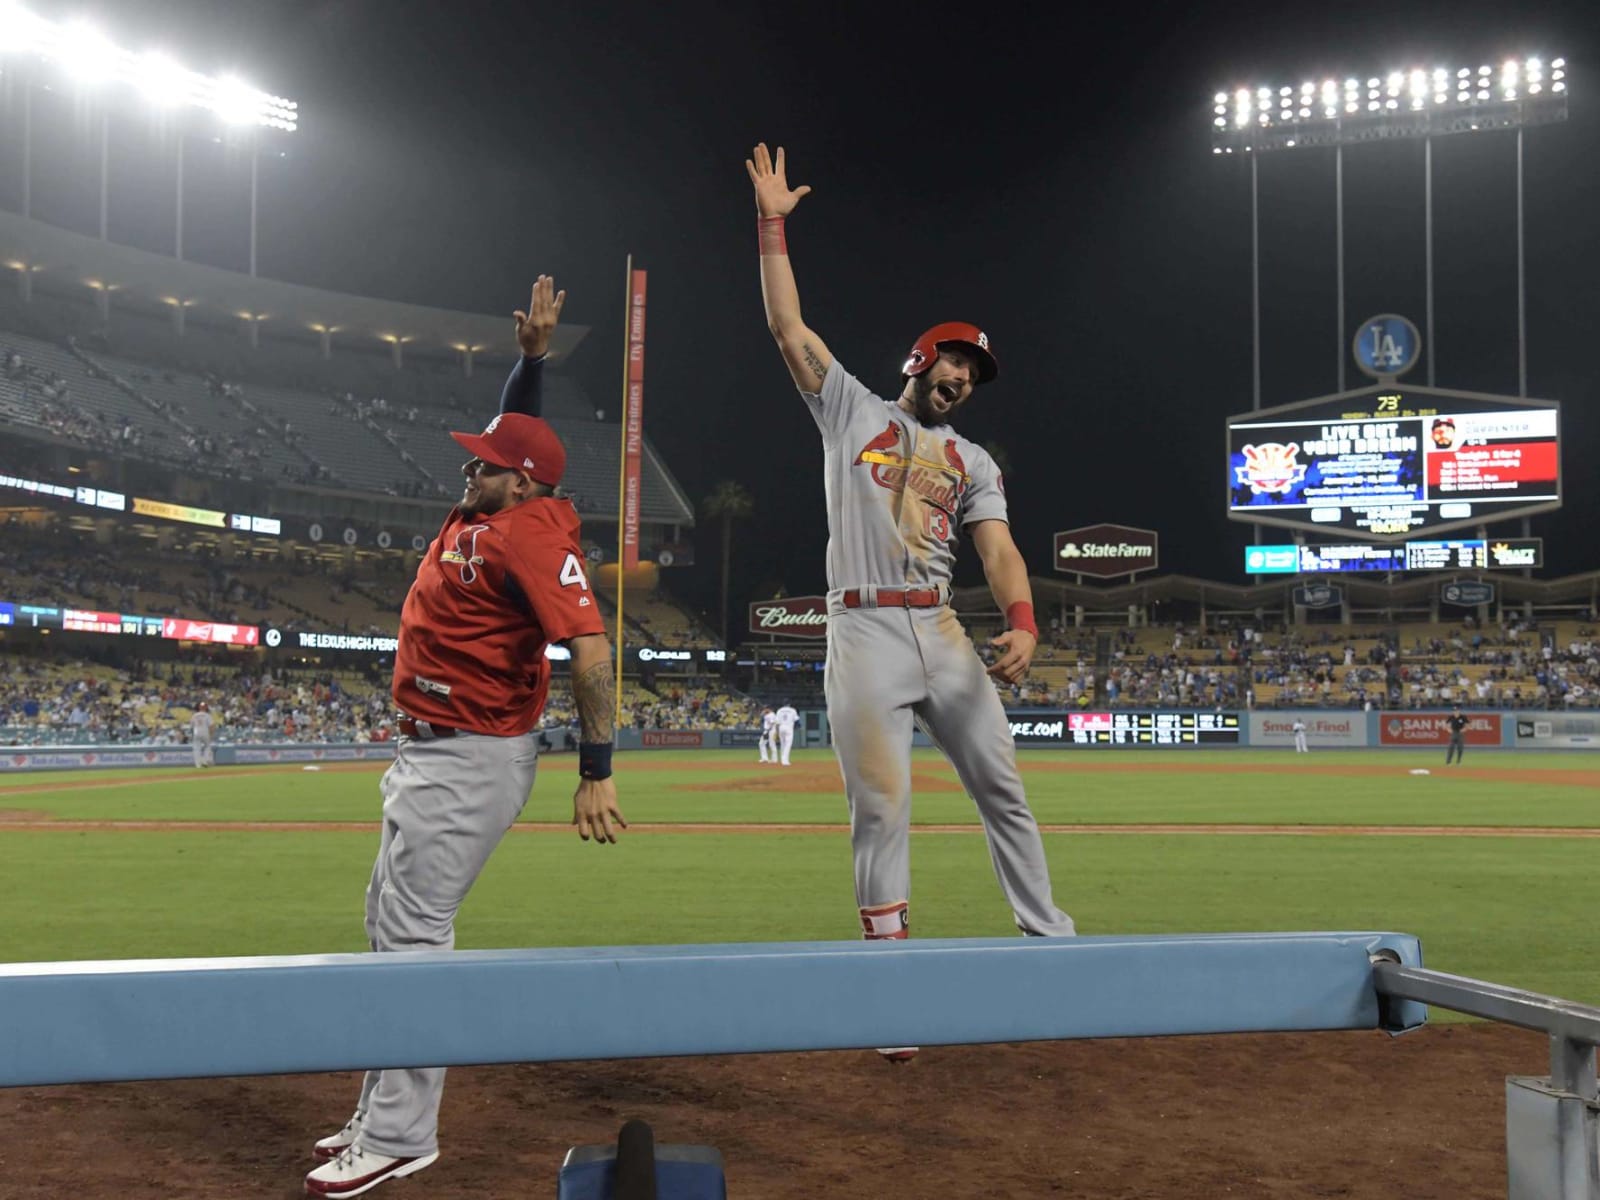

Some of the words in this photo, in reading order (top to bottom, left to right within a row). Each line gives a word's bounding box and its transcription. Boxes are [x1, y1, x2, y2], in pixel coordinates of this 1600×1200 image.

[1371, 326, 1403, 366] LA
[923, 507, 949, 542] 13
[559, 554, 588, 591] 4
[299, 632, 317, 647] THE
[317, 634, 347, 649] LEXUS
[1316, 720, 1350, 732] Final
[1403, 719, 1431, 731] SAN
